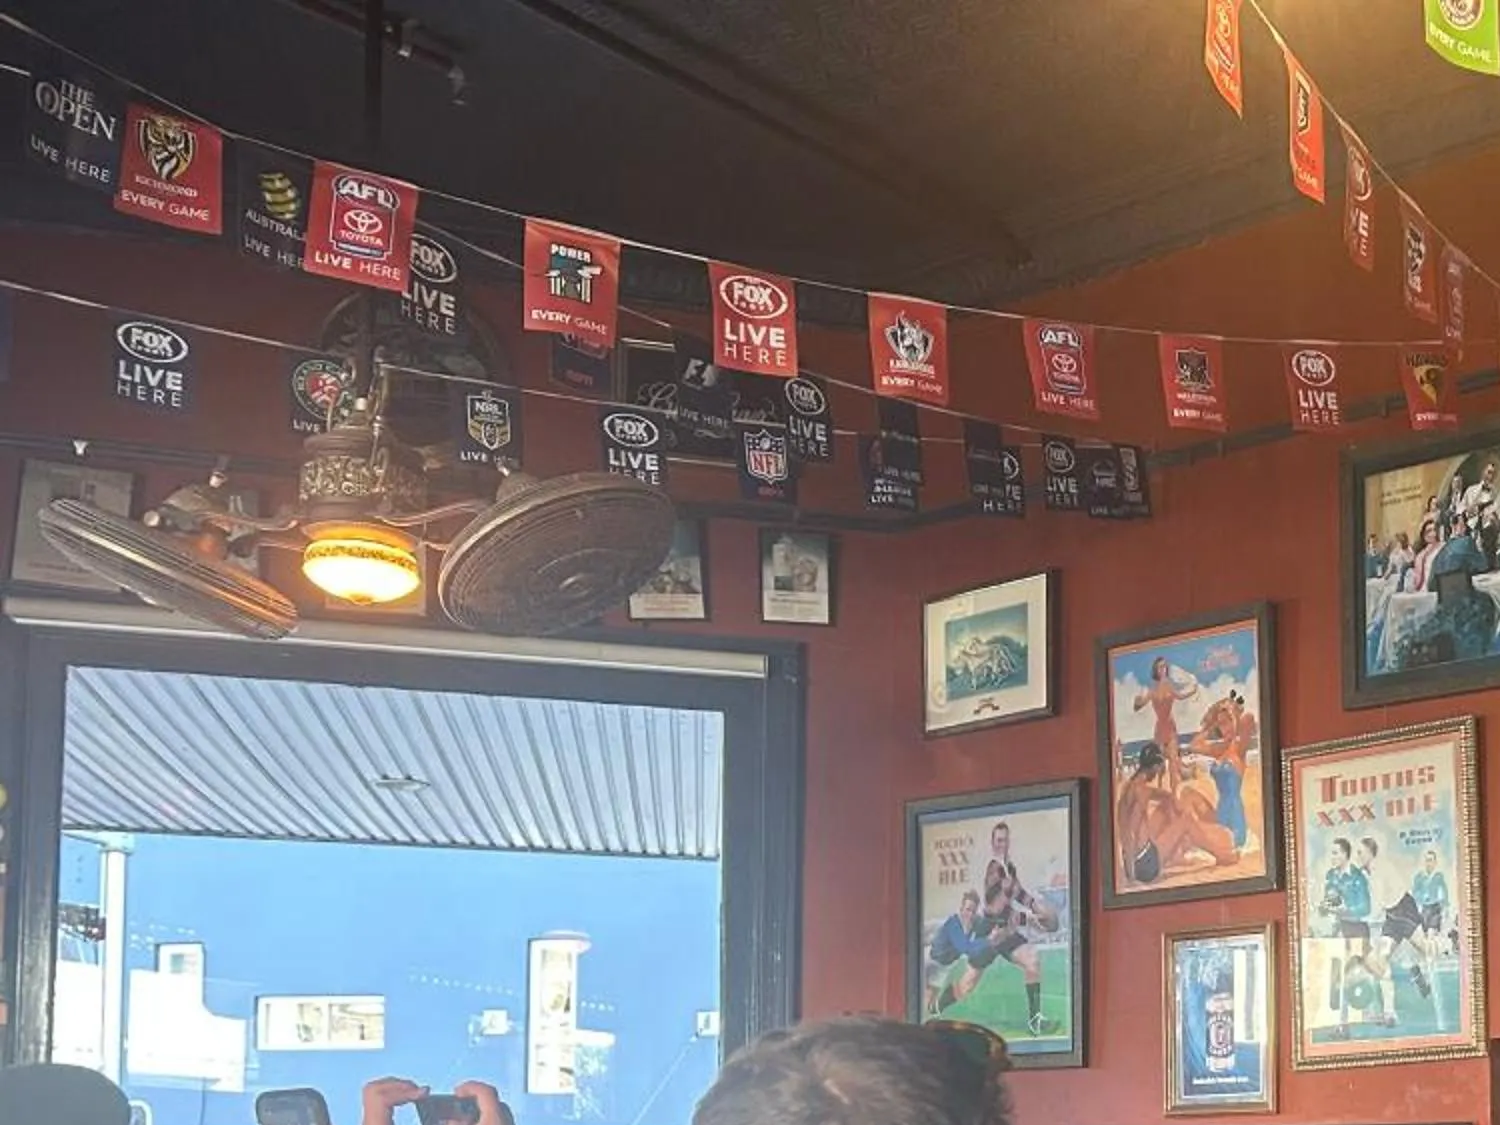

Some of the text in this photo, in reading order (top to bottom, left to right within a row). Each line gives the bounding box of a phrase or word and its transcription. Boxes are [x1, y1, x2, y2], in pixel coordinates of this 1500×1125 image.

[35, 81, 117, 142] OPEN
[31, 134, 110, 183] LIVE HERE
[339, 178, 393, 208] AFL
[121, 189, 210, 221] EVERY GAME
[244, 234, 271, 257] LIVE
[340, 229, 384, 246] TOYOTA
[551, 244, 592, 262] POWER
[315, 252, 401, 281] LIVE HERE
[401, 281, 455, 316] LIVE
[731, 281, 773, 305] FOX
[401, 301, 456, 335] HERE
[531, 309, 570, 325] EVERY
[131, 327, 173, 350] FOX
[724, 319, 785, 349] LIVE
[1041, 329, 1081, 347] AFL
[724, 343, 787, 367] HERE
[1299, 355, 1326, 374] FOX
[118, 360, 183, 391] LIVE
[117, 381, 182, 408] HERE
[791, 384, 817, 405] FOX
[1041, 391, 1094, 410] LIVE HERE
[1298, 389, 1337, 410] LIVE
[293, 418, 320, 433] LIVE
[614, 418, 648, 438] FOX
[789, 415, 827, 441] LIVE
[1300, 409, 1340, 425] HERE
[461, 452, 488, 463] LIVE
[607, 448, 659, 471] LIVE
[752, 453, 786, 475] NFL
[1047, 475, 1079, 493] LIVE
[1317, 802, 1376, 828] XXX
[938, 851, 970, 867] XXX
